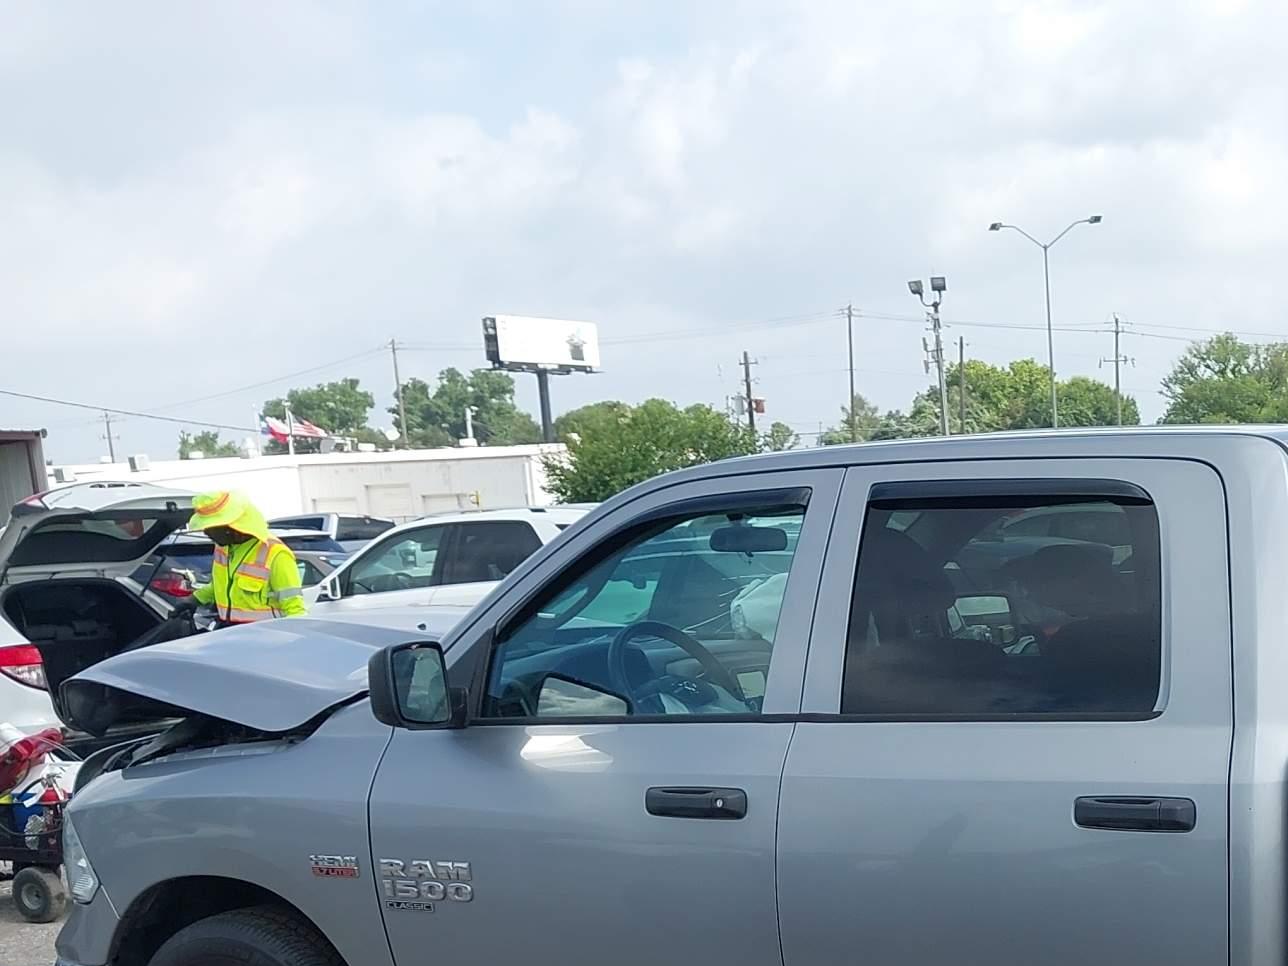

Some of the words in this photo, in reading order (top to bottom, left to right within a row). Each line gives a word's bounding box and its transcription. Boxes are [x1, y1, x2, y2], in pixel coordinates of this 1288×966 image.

[379, 858, 472, 881] RAM
[382, 880, 473, 902] 1500
[387, 902, 432, 912] CLASSIC
